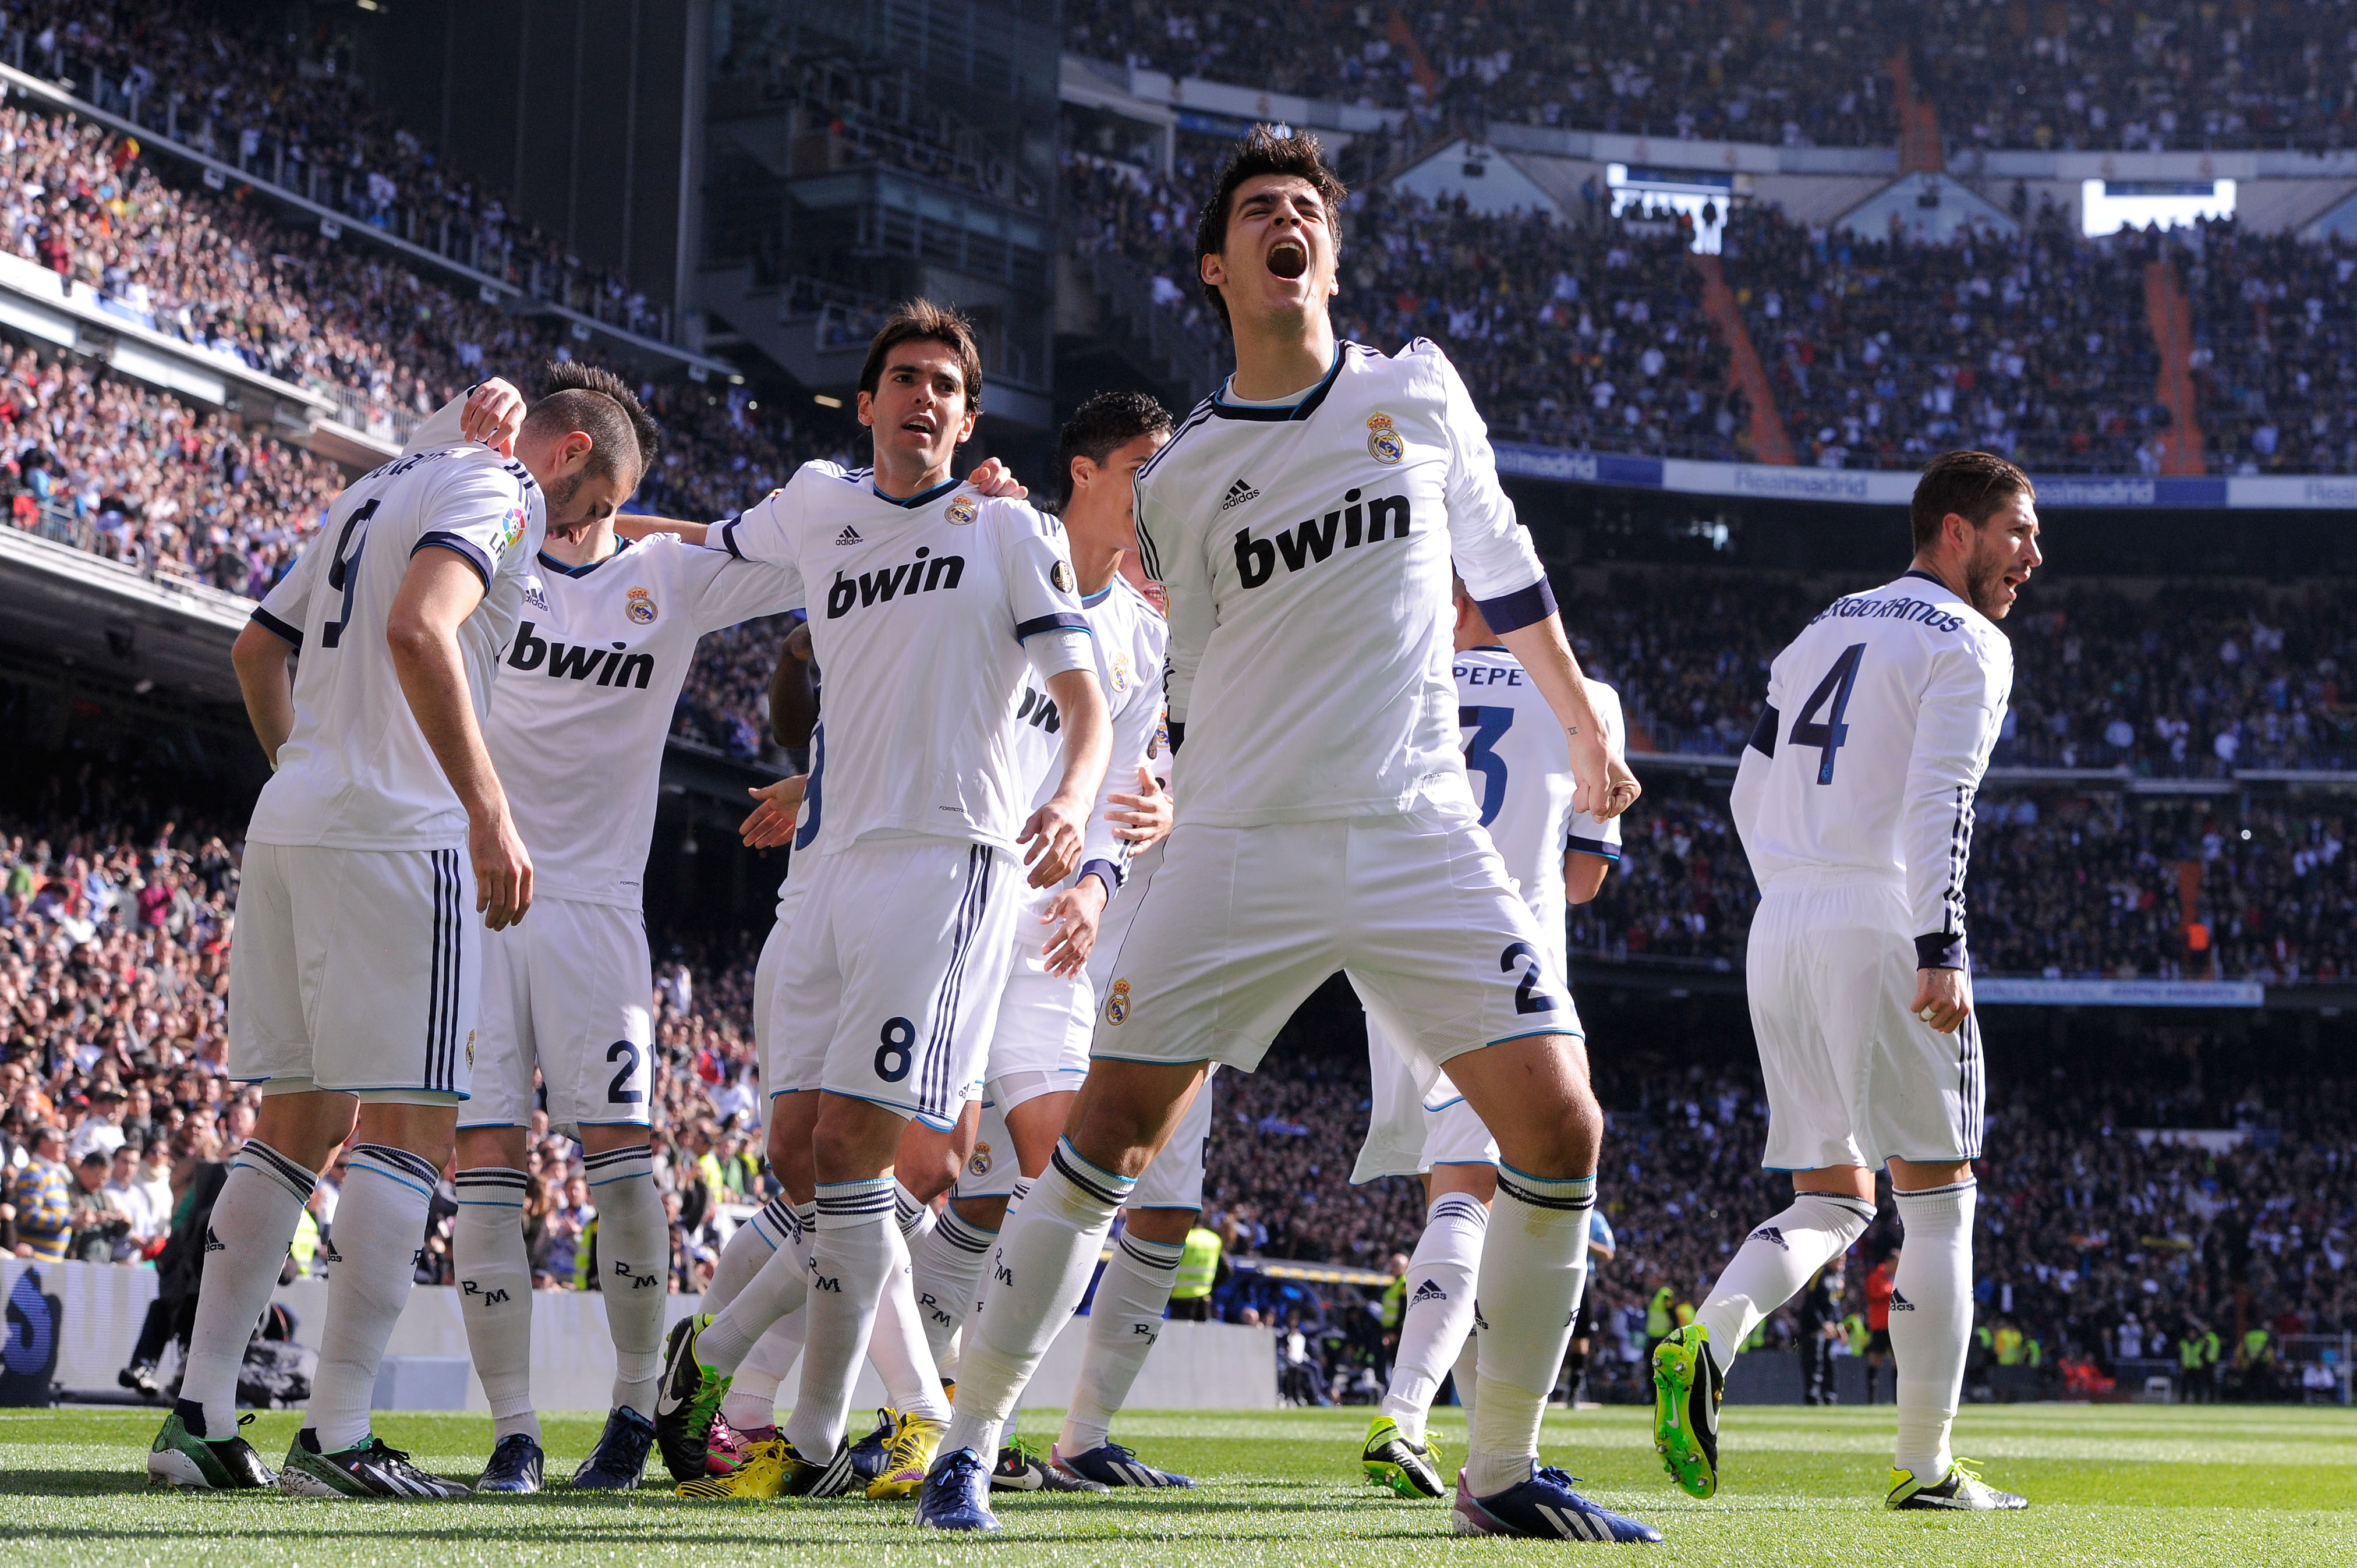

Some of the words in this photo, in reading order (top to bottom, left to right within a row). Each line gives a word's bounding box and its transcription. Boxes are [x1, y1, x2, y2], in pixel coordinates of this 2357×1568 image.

[1223, 489, 1260, 510] adidas
[836, 537, 863, 546] adidas
[1234, 488, 1410, 589] bwin
[322, 499, 381, 649] 9
[525, 594, 548, 611] didas
[827, 546, 965, 619] bwin
[1873, 597, 1966, 633] RAMOS
[507, 622, 654, 689] bwin
[1454, 667, 1525, 686] PEPE
[1788, 643, 1867, 785] 4
[1457, 705, 1514, 829] 3
[874, 1017, 916, 1082] 8
